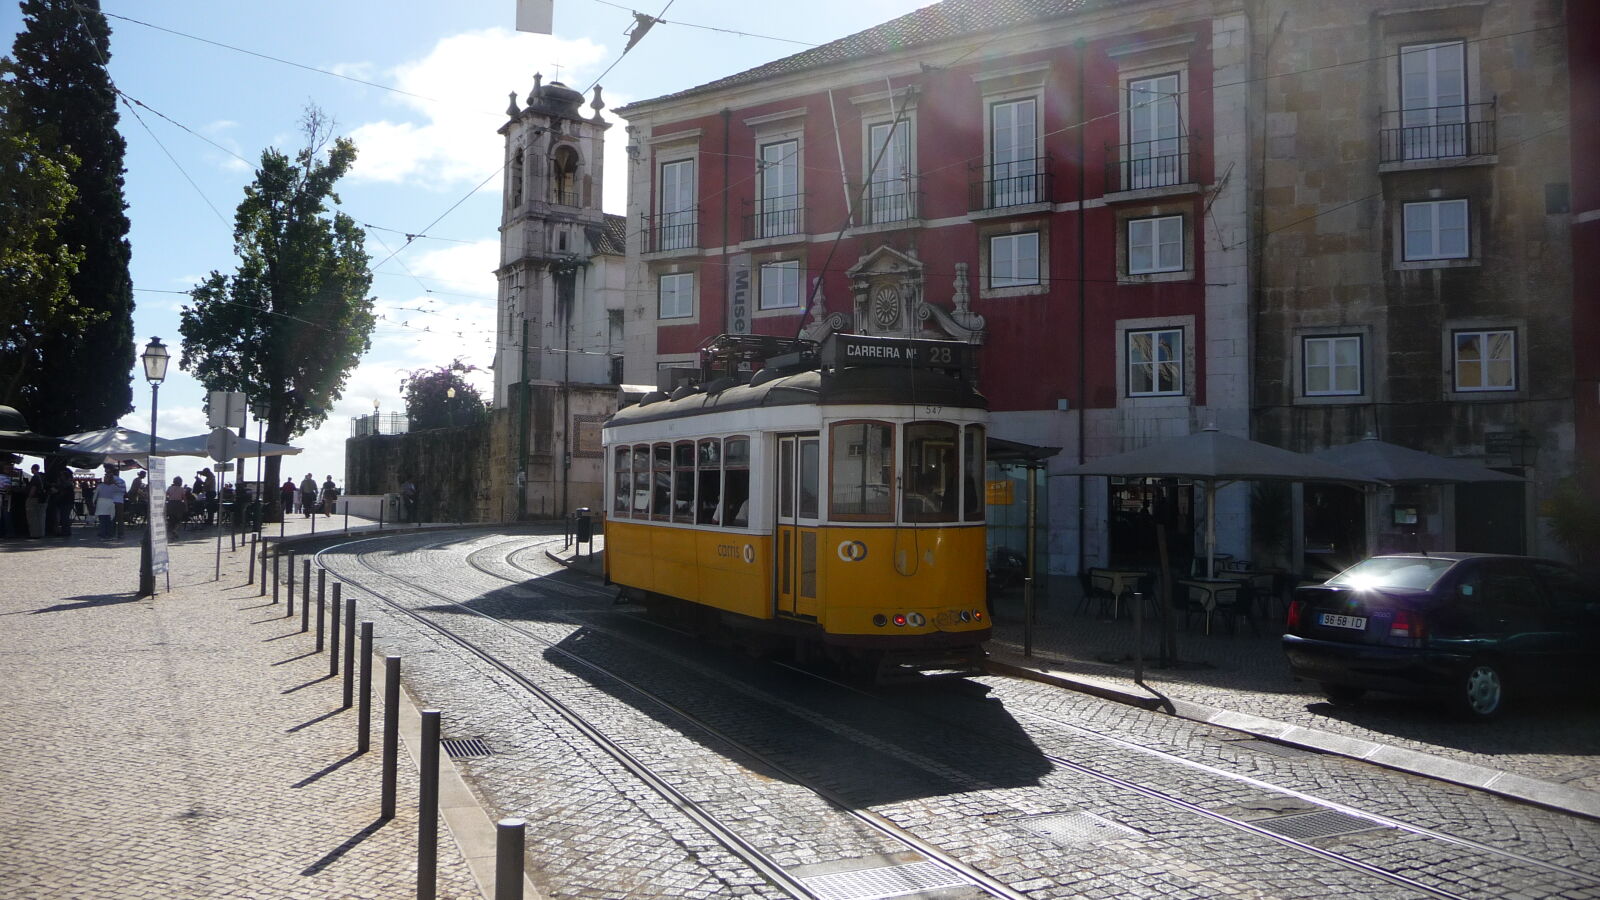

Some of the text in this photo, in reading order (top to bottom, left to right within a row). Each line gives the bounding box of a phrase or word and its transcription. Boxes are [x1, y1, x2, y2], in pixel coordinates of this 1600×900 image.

[735, 270, 748, 334] Muse
[847, 344, 900, 358] CARREIRA
[930, 347, 952, 363] 28
[926, 406, 942, 416] 547
